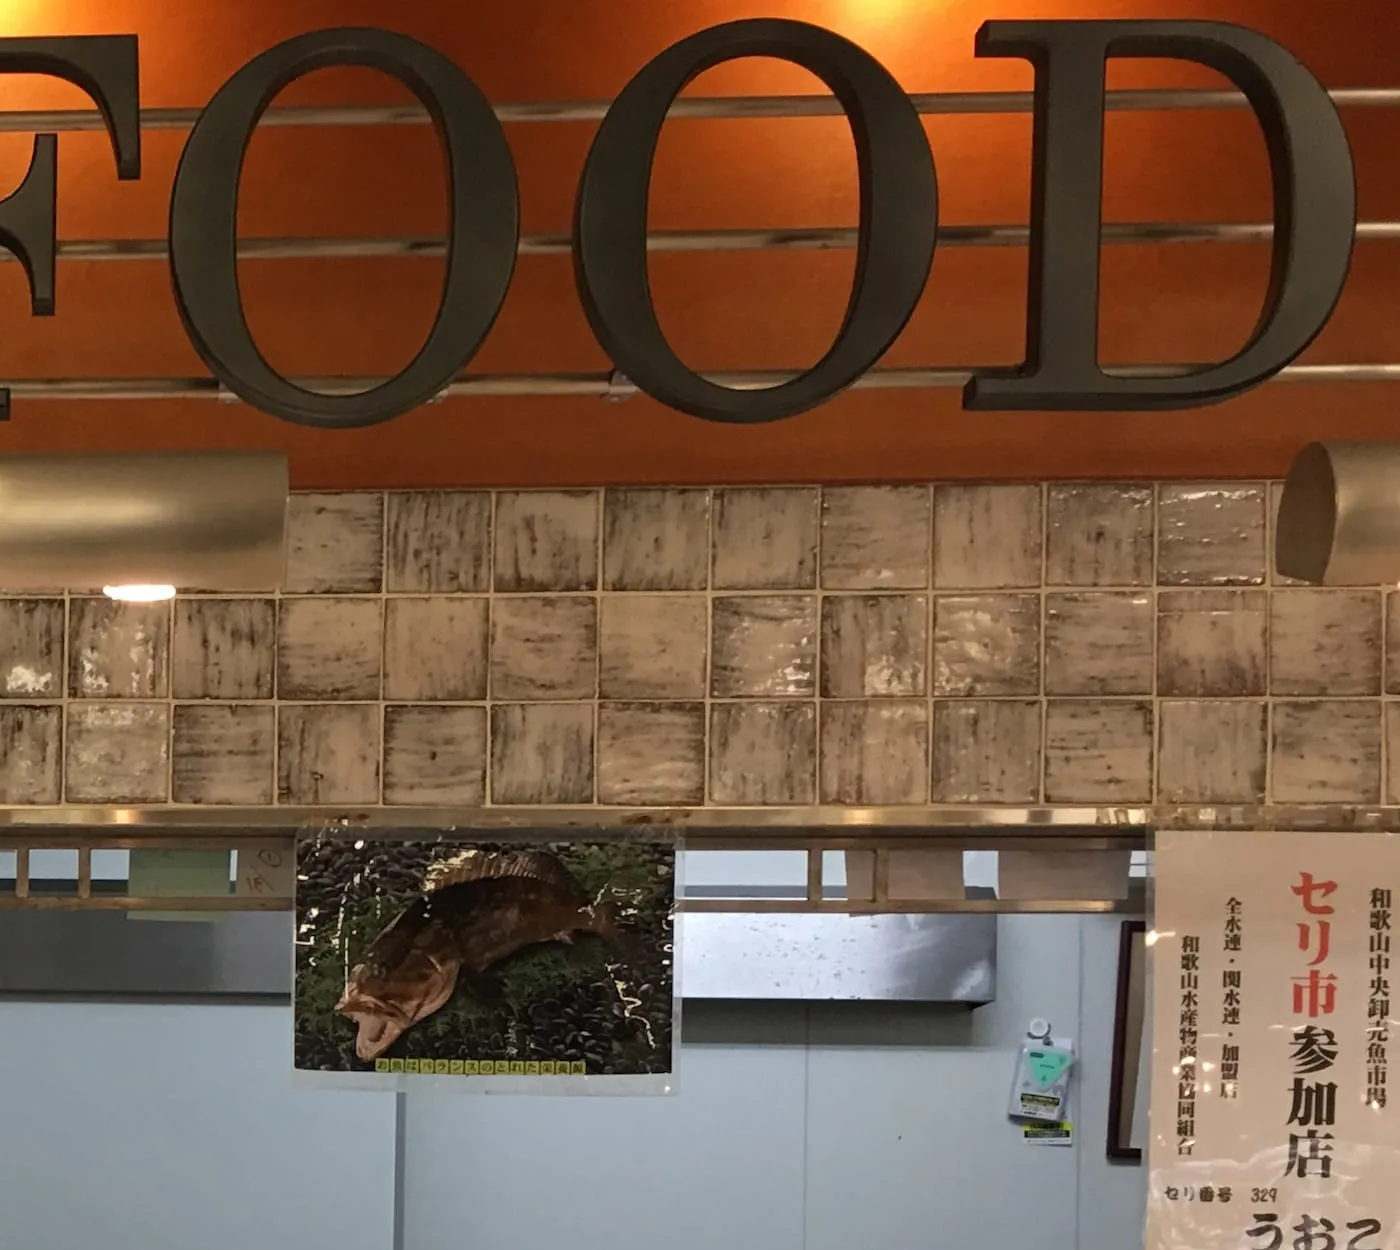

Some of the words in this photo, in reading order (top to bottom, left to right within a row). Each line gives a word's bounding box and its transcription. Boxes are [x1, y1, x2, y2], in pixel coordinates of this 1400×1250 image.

[1285, 871, 1339, 1178] セリ市参加店
[1165, 1185, 1232, 1203] セリ番号
[1251, 1187, 1278, 1203] 329
